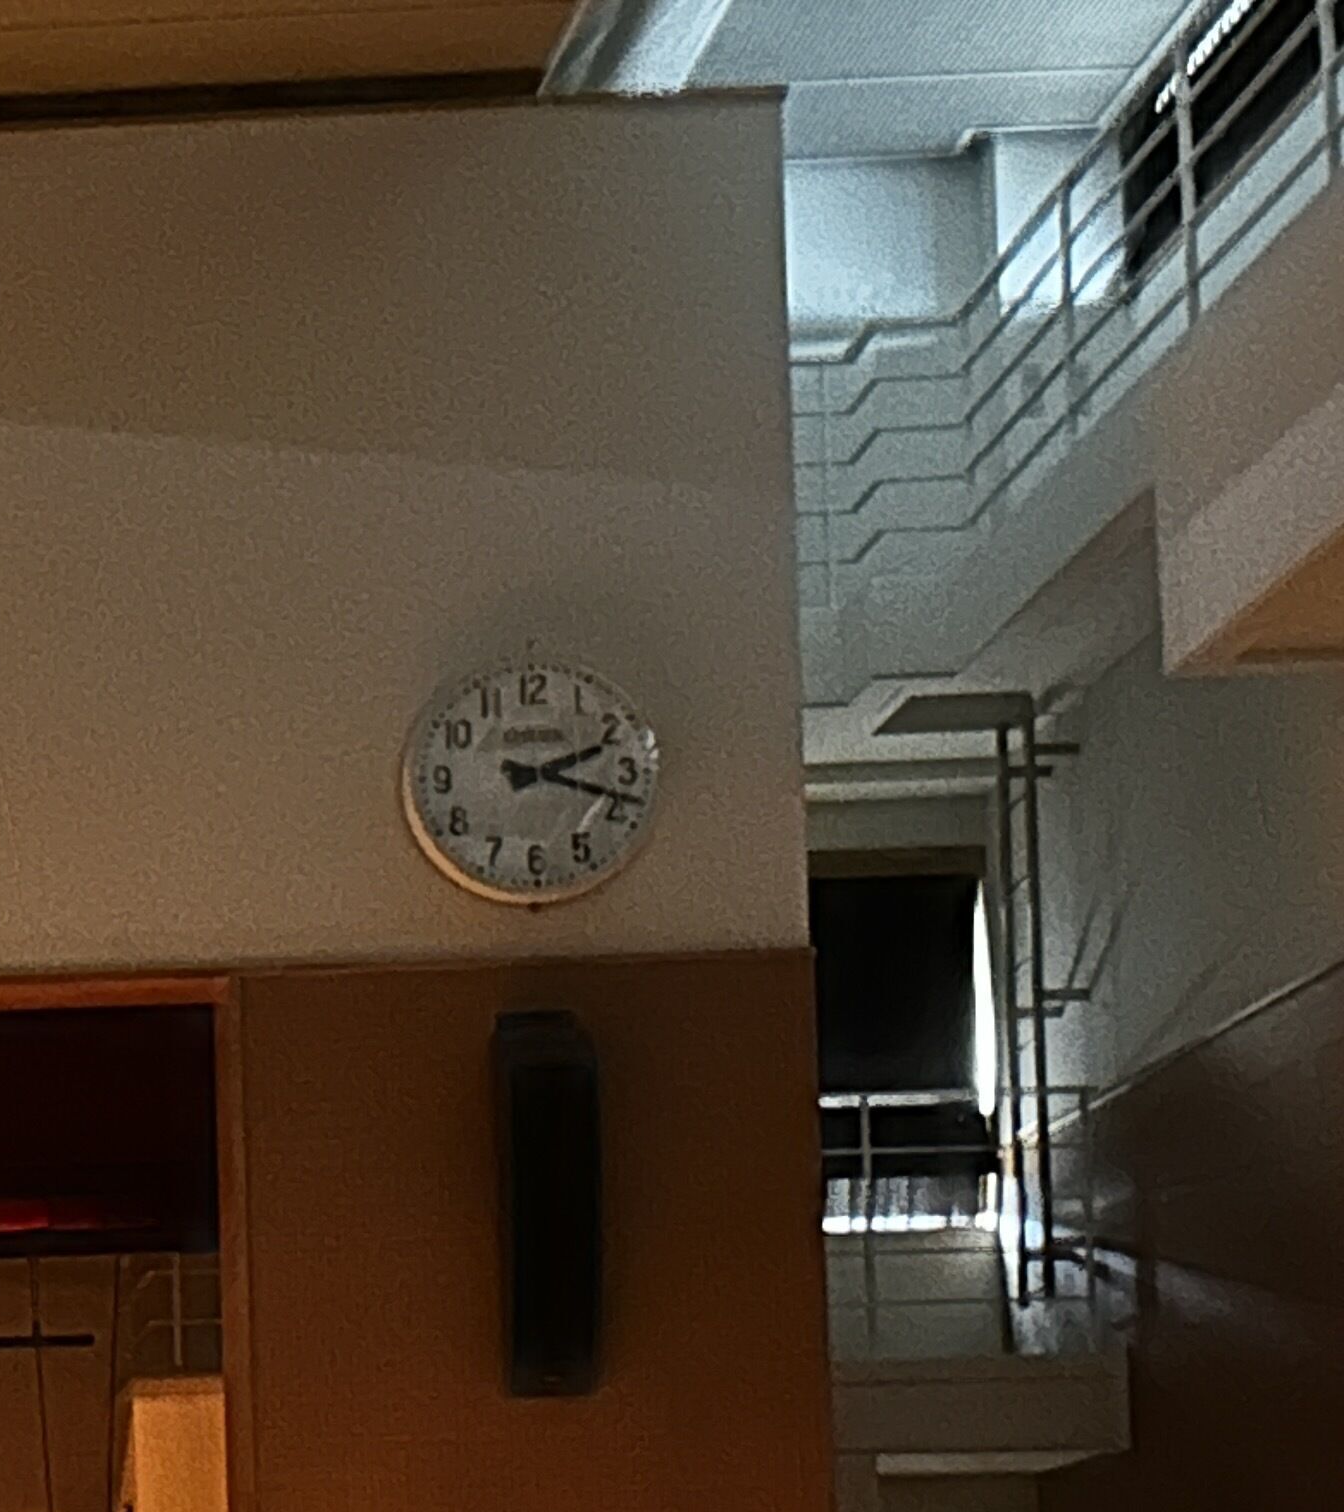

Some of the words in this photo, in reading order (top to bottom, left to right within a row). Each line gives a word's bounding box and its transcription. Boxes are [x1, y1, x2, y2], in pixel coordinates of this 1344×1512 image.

[474, 686, 502, 718] 11
[519, 674, 548, 705] 12
[444, 718, 472, 750] 10
[602, 713, 620, 746] 2
[432, 765, 453, 795] 9
[617, 756, 638, 786] 3
[448, 806, 469, 836] 8
[485, 836, 503, 867] 7
[527, 845, 548, 876] 6
[571, 832, 591, 864] 5
